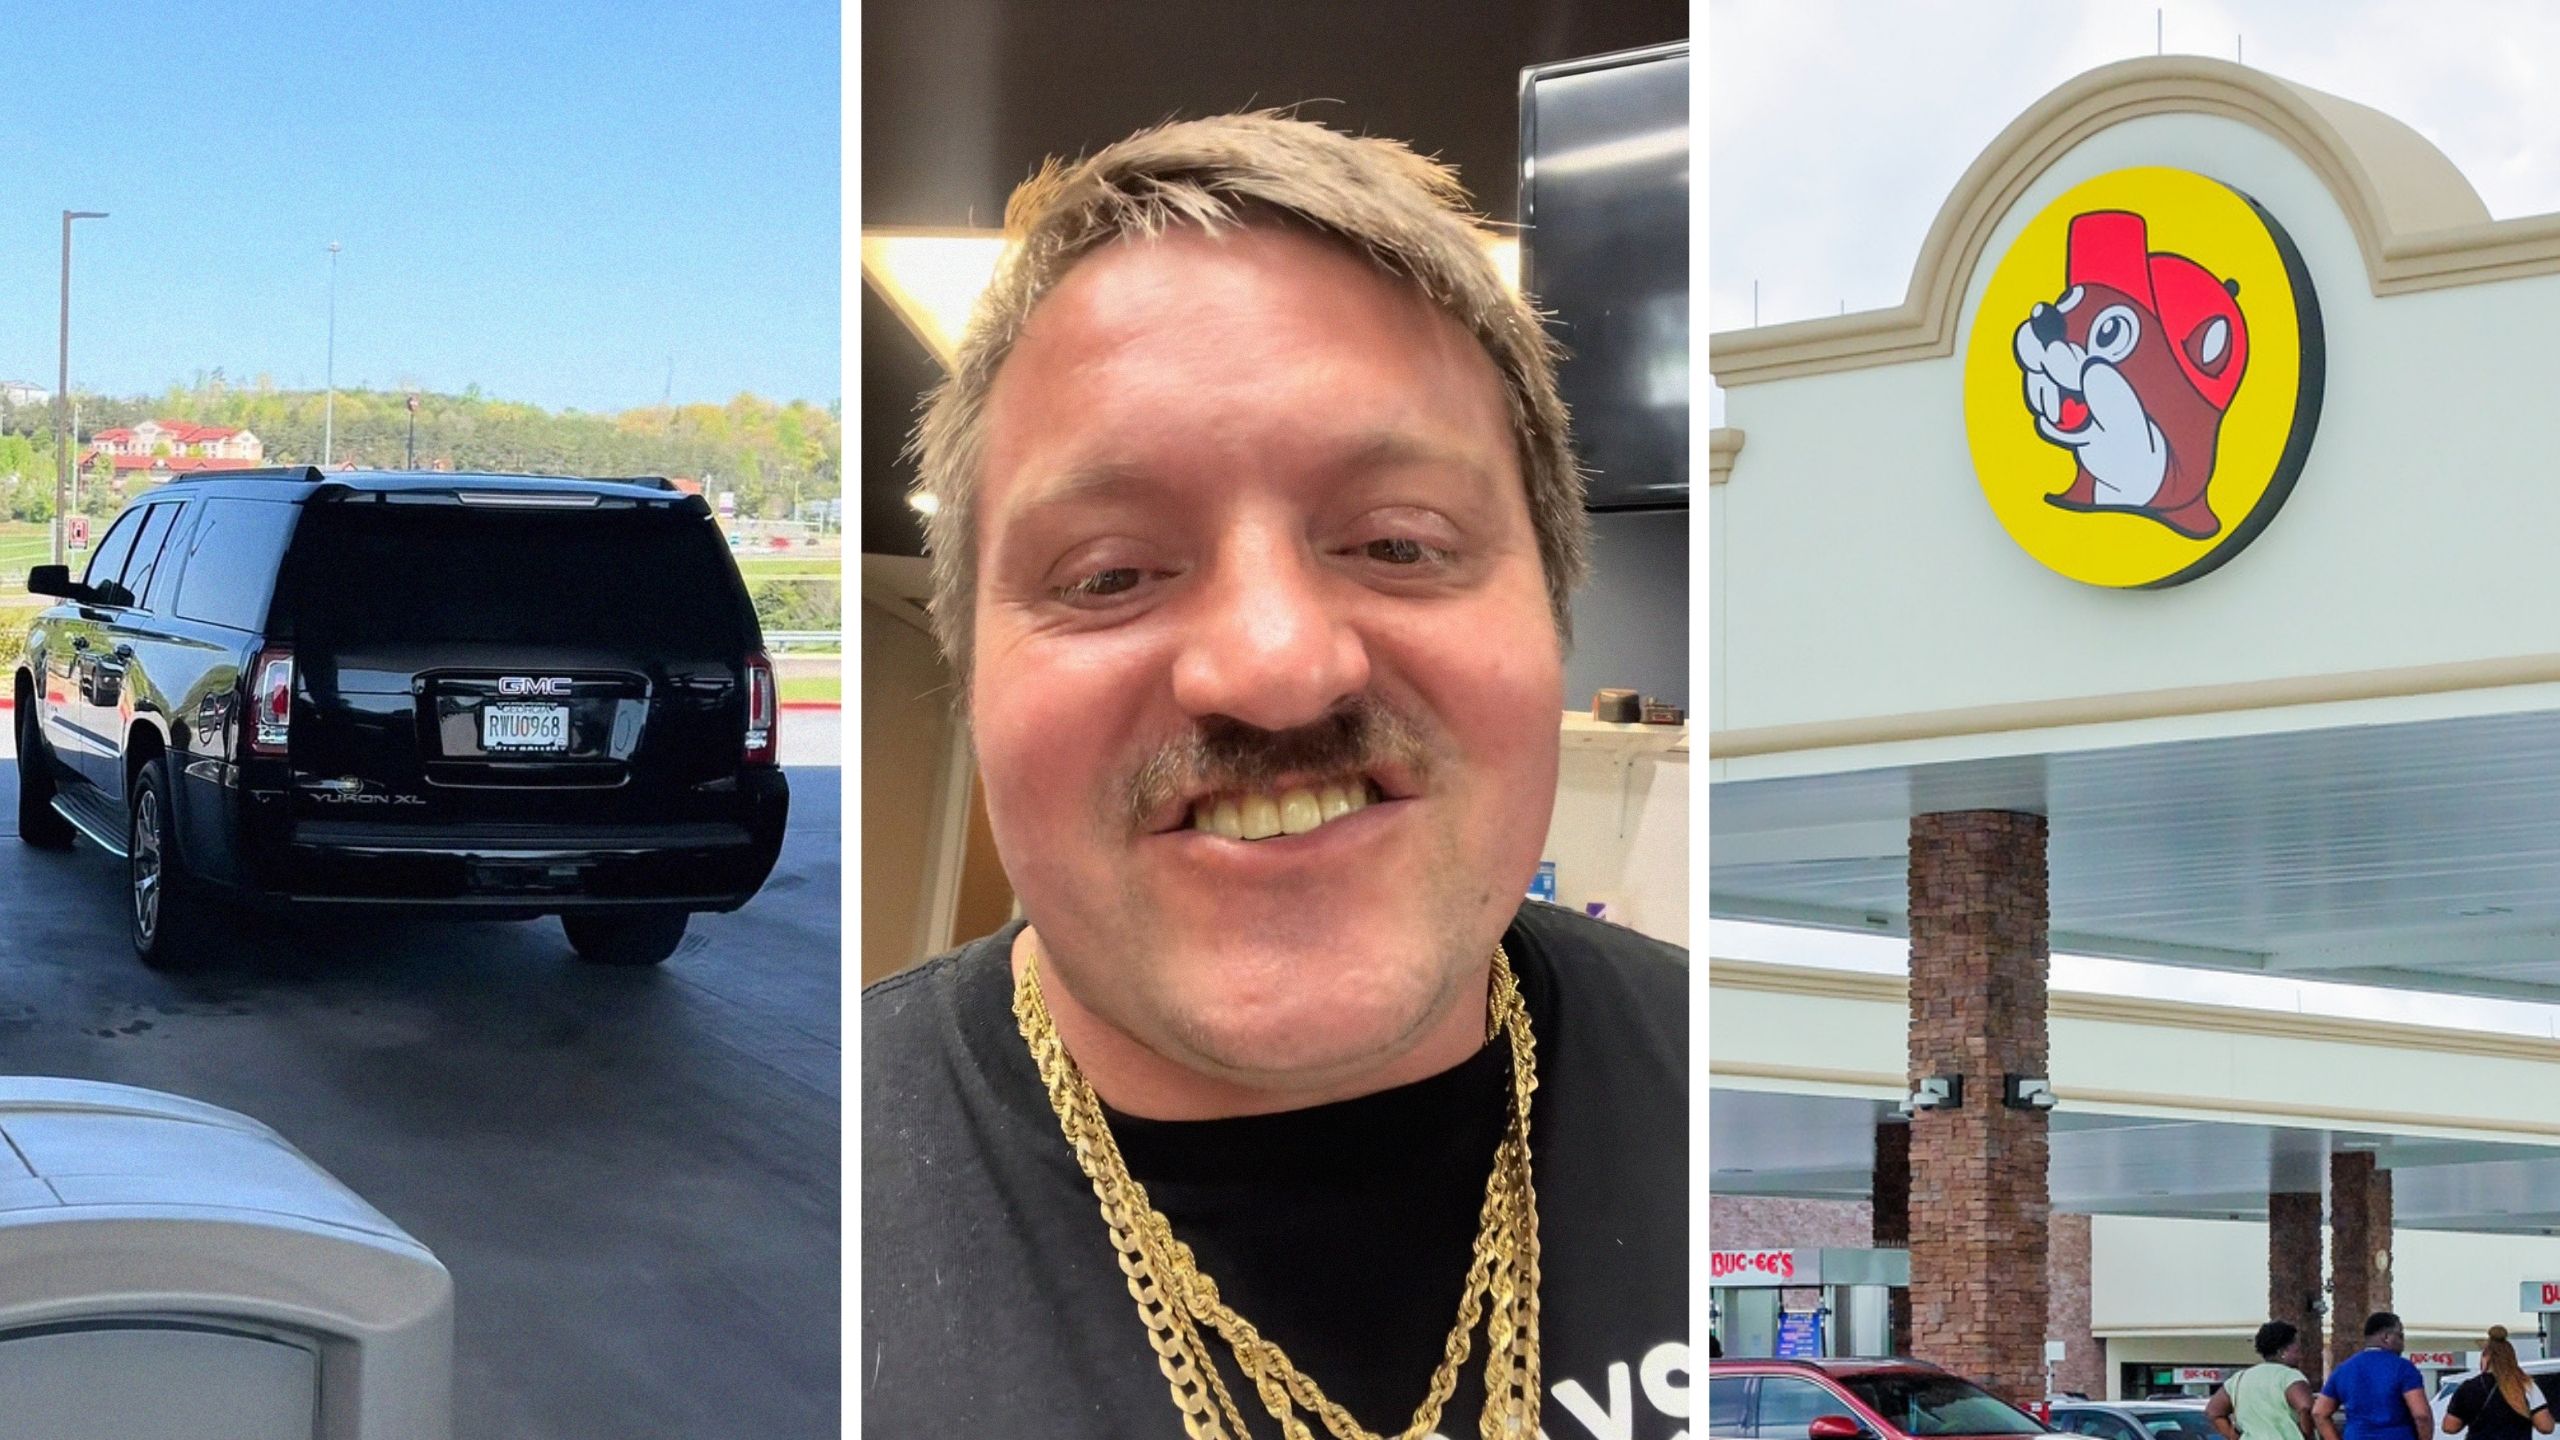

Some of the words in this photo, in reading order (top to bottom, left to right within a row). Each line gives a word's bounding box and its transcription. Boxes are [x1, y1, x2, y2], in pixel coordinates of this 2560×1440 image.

[499, 677, 573, 695] GMC
[490, 715, 561, 738] RWU0968
[309, 793, 390, 803] YUKON
[394, 795, 427, 805] XL
